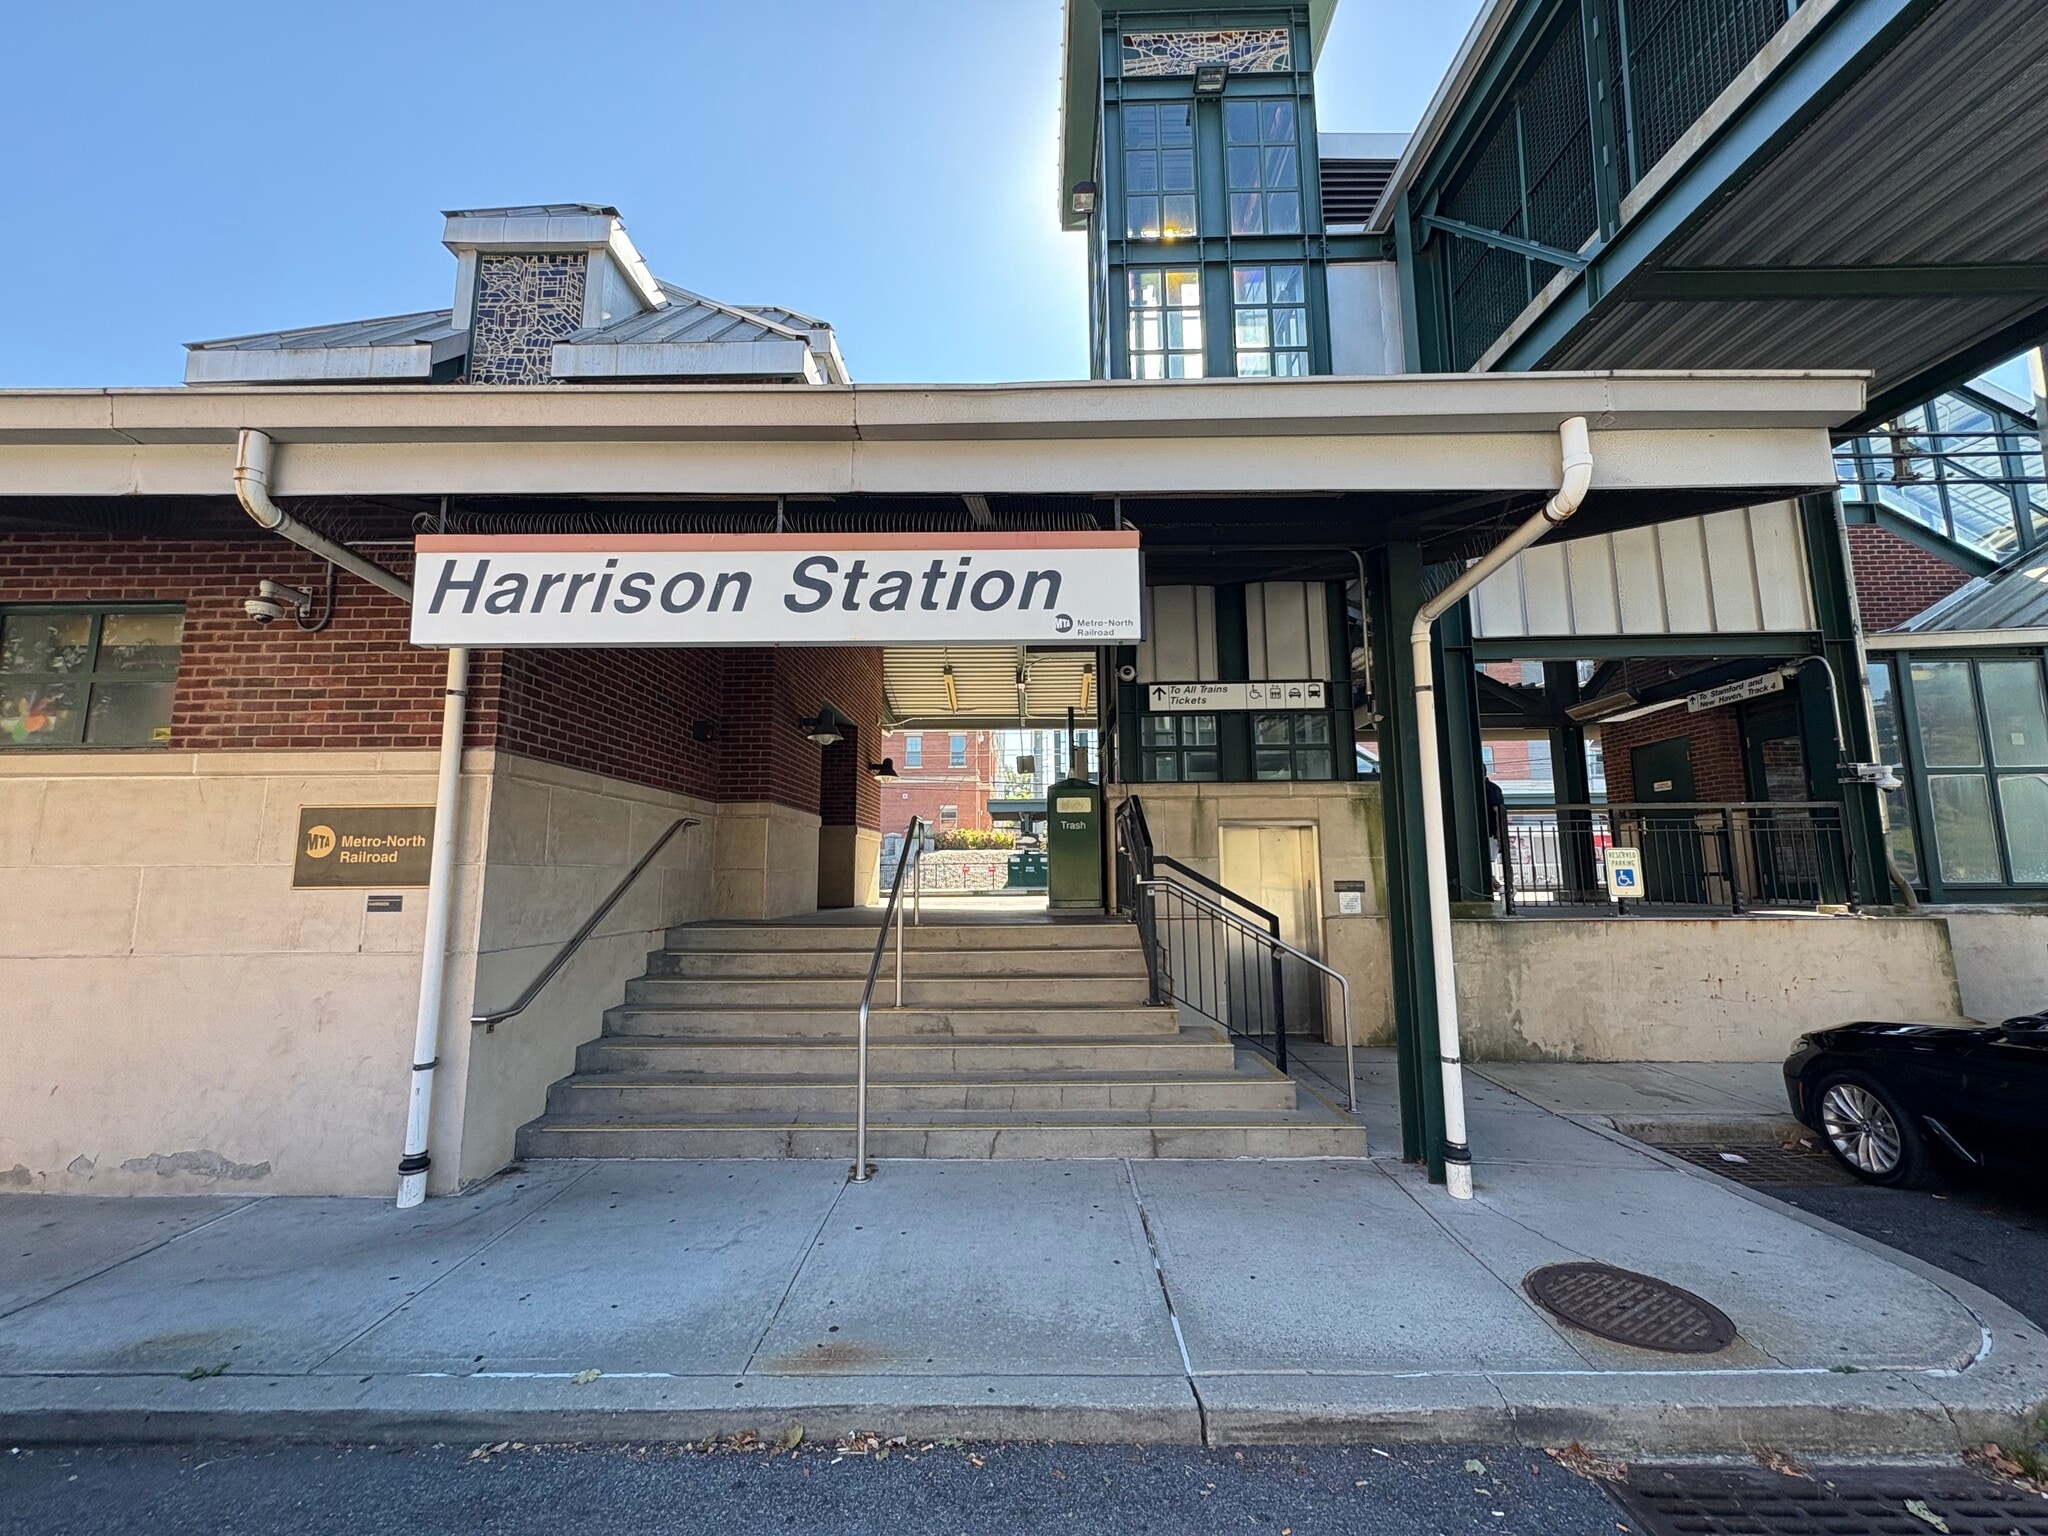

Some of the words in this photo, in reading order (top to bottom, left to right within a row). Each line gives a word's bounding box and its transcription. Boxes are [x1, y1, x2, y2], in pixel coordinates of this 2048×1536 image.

[428, 558, 753, 615] Harrison
[783, 555, 1063, 613] Station
[1077, 619, 1134, 627] Metro-North
[1170, 686, 1181, 694] To
[1183, 686, 1197, 694] All
[1200, 685, 1228, 694] Trains
[1710, 682, 1744, 697] Stamford
[1748, 677, 1763, 687] and
[1170, 696, 1207, 704] Tickets
[1700, 700, 1715, 708] New
[1748, 684, 1768, 695] Track
[1061, 821, 1086, 830] Trash
[306, 829, 333, 854] MTA
[341, 835, 426, 848] Metro-North
[340, 851, 398, 863] Railroad
[1608, 851, 1636, 859] RESERVED
